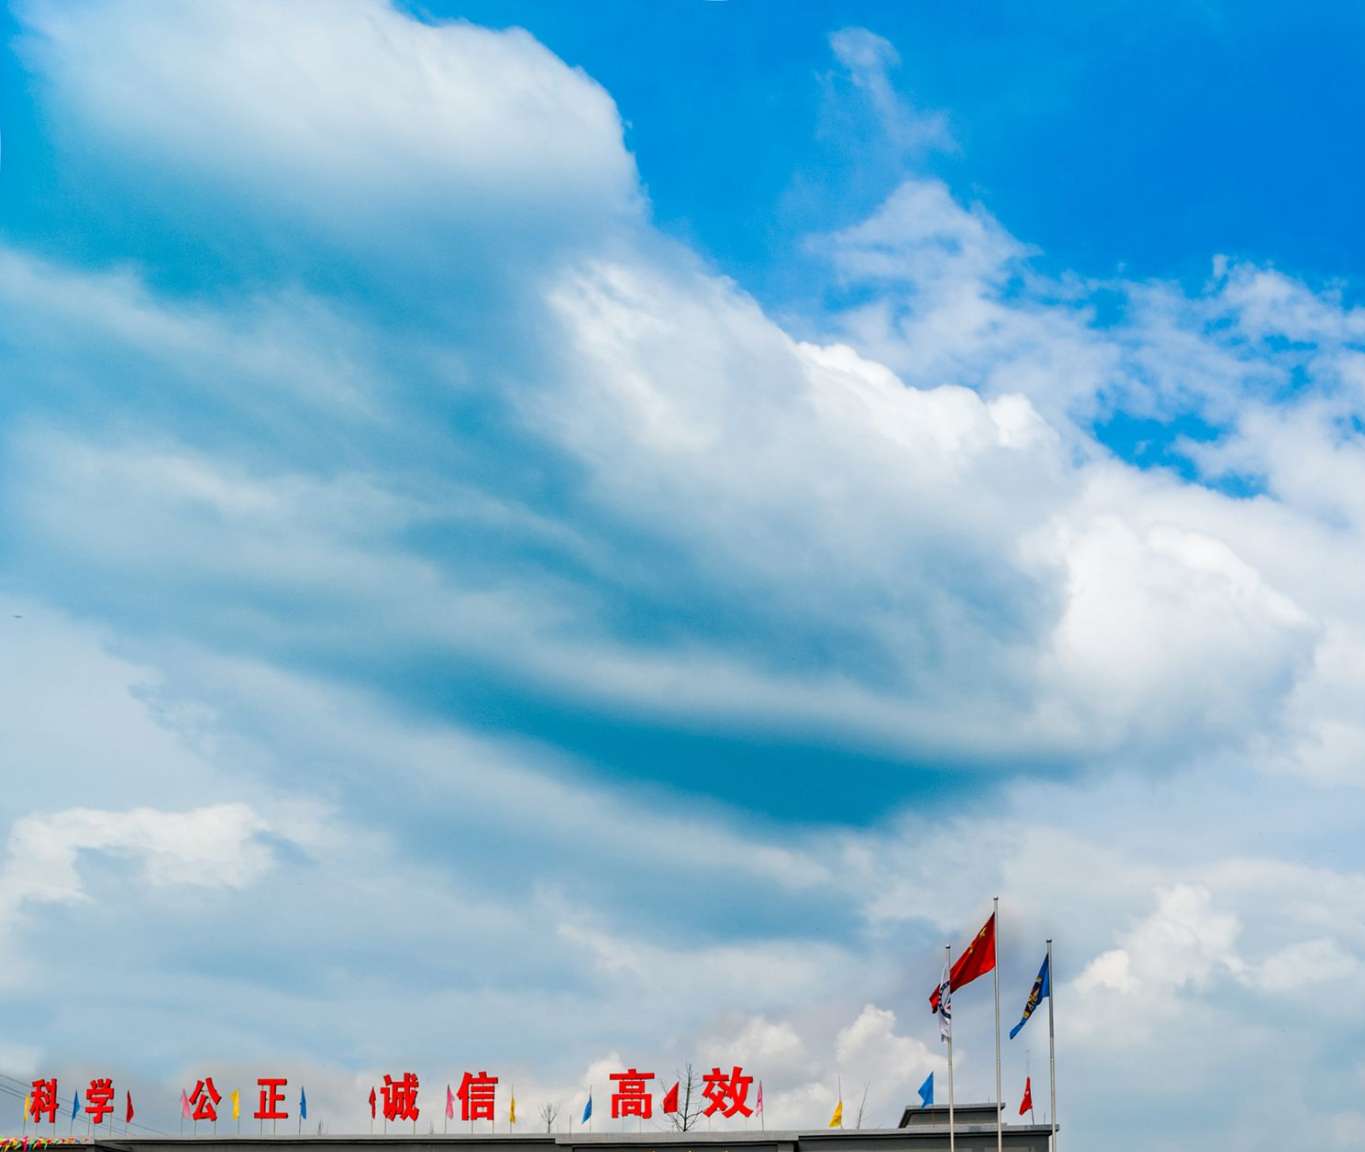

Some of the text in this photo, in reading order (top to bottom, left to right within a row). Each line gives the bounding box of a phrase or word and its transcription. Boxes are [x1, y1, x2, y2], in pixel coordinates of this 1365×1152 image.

[29, 1065, 754, 1124] 科学 公正 诚信 高效
